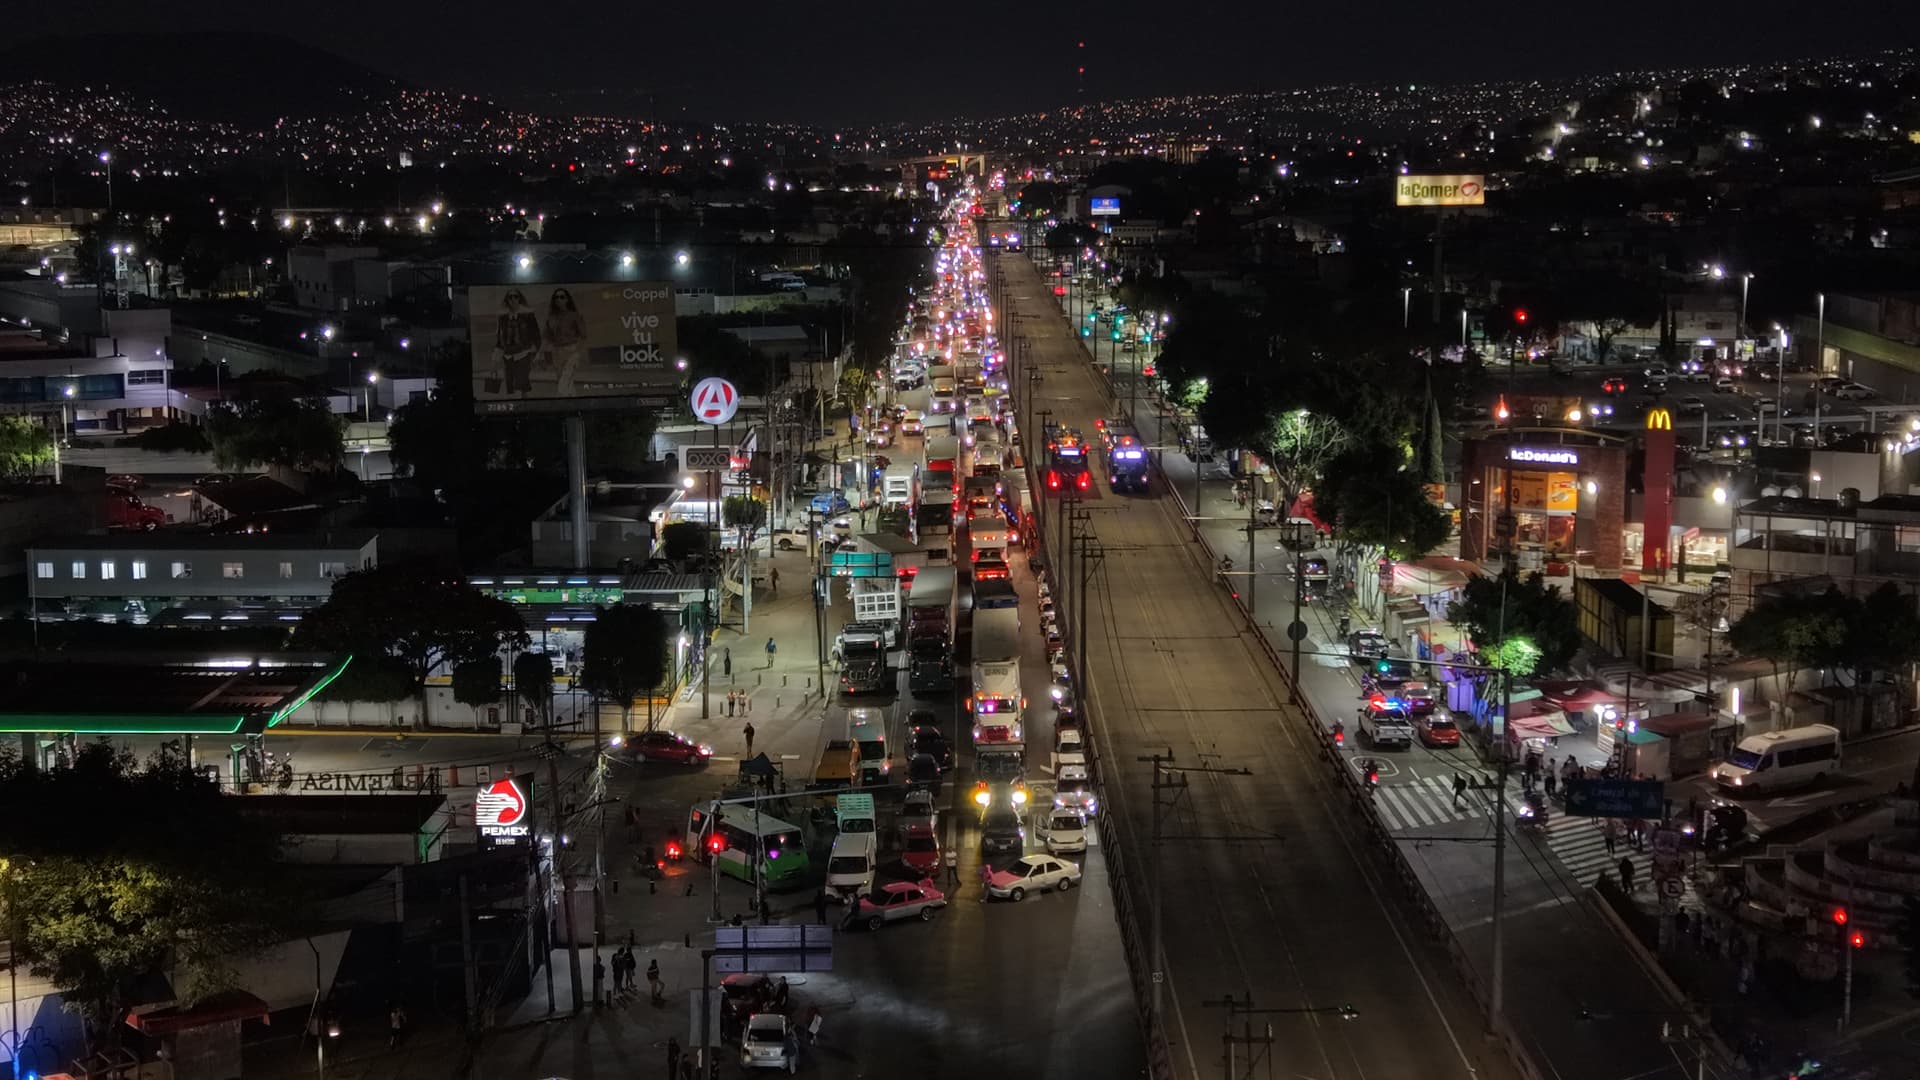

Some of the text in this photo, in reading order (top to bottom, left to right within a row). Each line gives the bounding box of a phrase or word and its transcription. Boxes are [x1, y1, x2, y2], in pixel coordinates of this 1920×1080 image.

[623, 287, 669, 302] Coppel
[621, 311, 659, 328] vive
[632, 328, 652, 344] tu
[619, 344, 664, 363] look.
[688, 453, 728, 465] OXXO
[482, 827, 528, 837] PEMEX
